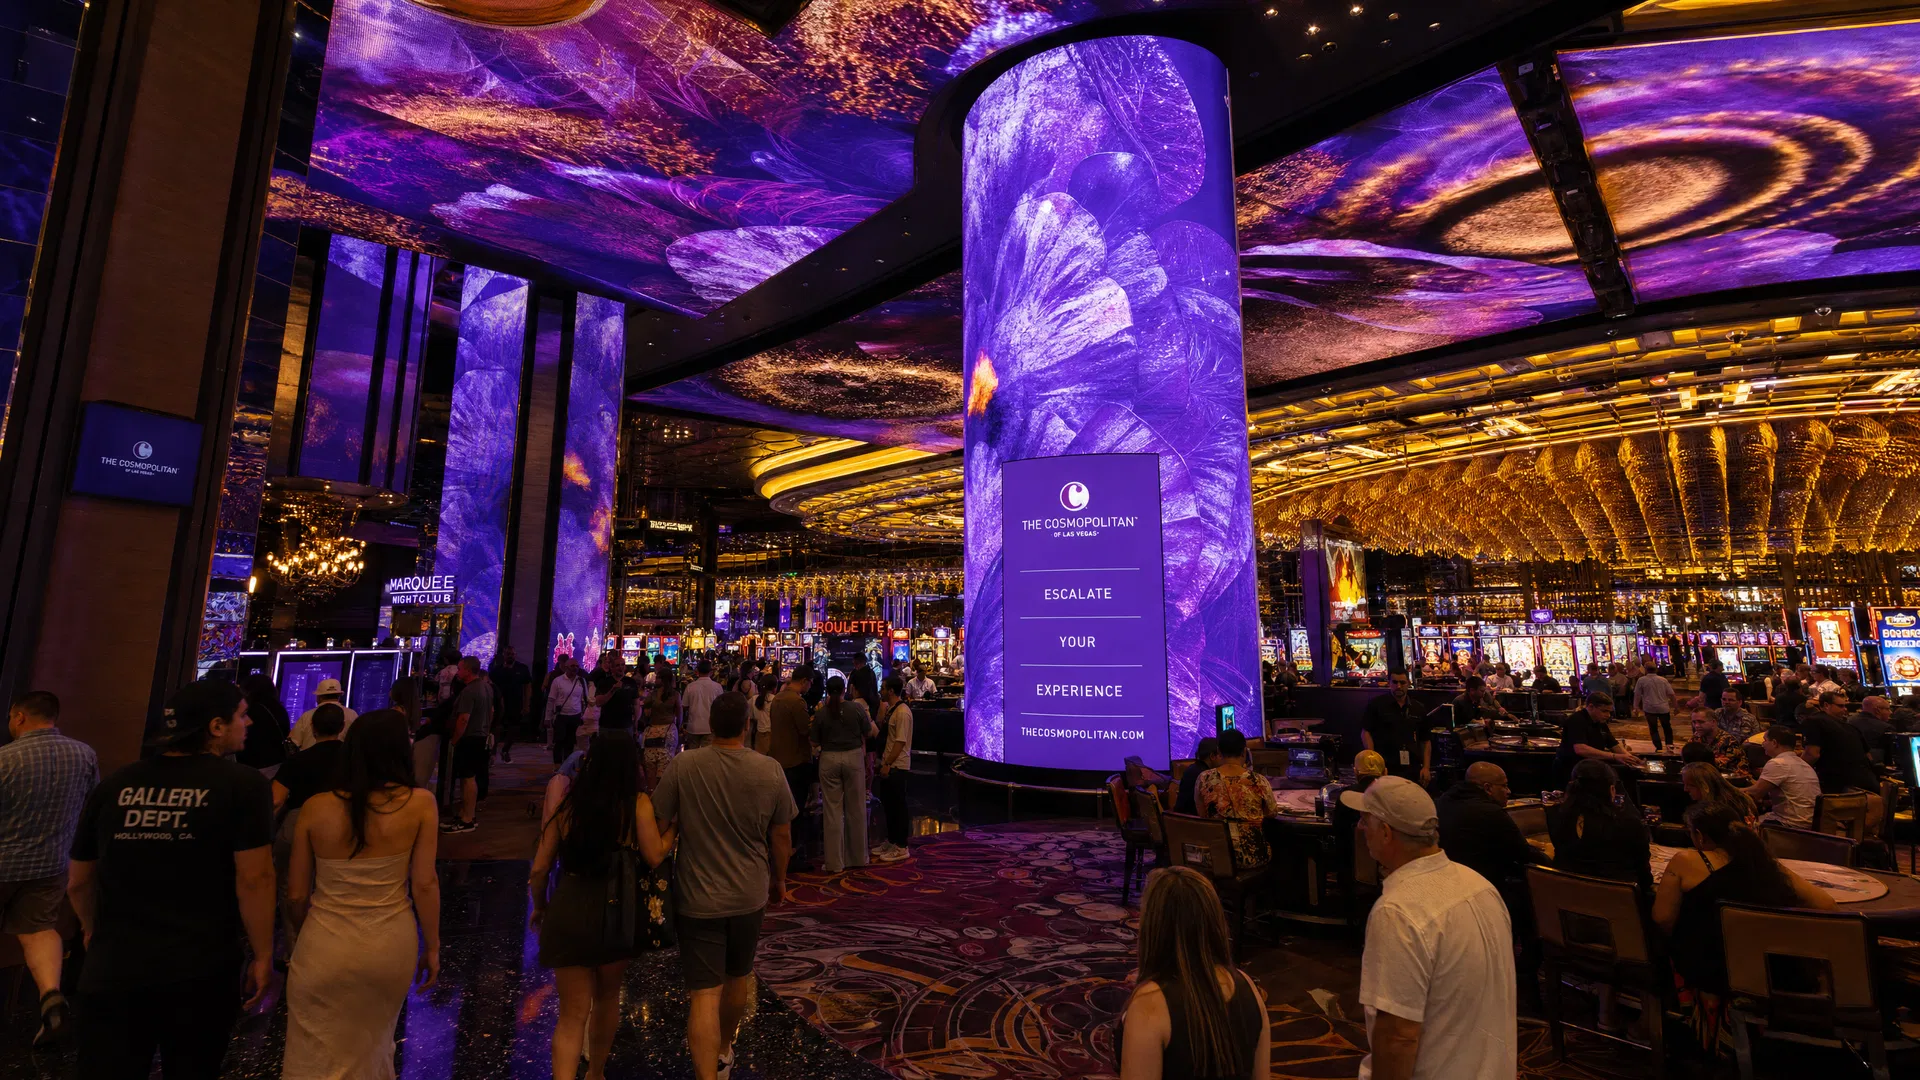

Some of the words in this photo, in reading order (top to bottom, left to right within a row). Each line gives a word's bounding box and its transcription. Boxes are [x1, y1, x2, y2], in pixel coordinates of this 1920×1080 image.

[101, 456, 117, 466] THE
[119, 459, 178, 475] COSMOPOLITAN
[1022, 520, 1042, 530] THE
[1045, 516, 1134, 529] COSMOPOLITAN
[389, 575, 455, 591] MARQUEE
[392, 594, 451, 604] NIGHTCLUB
[1044, 587, 1112, 600] ESCALATE
[816, 620, 884, 633] ROULETTE
[1059, 636, 1096, 648] YOUR
[1036, 684, 1123, 697] EXPERIENCE
[1021, 726, 1145, 740] THECOSMOPOLITAN.COM
[124, 810, 188, 828] DEPT.
[114, 832, 174, 841] HOLLYWOOD,
